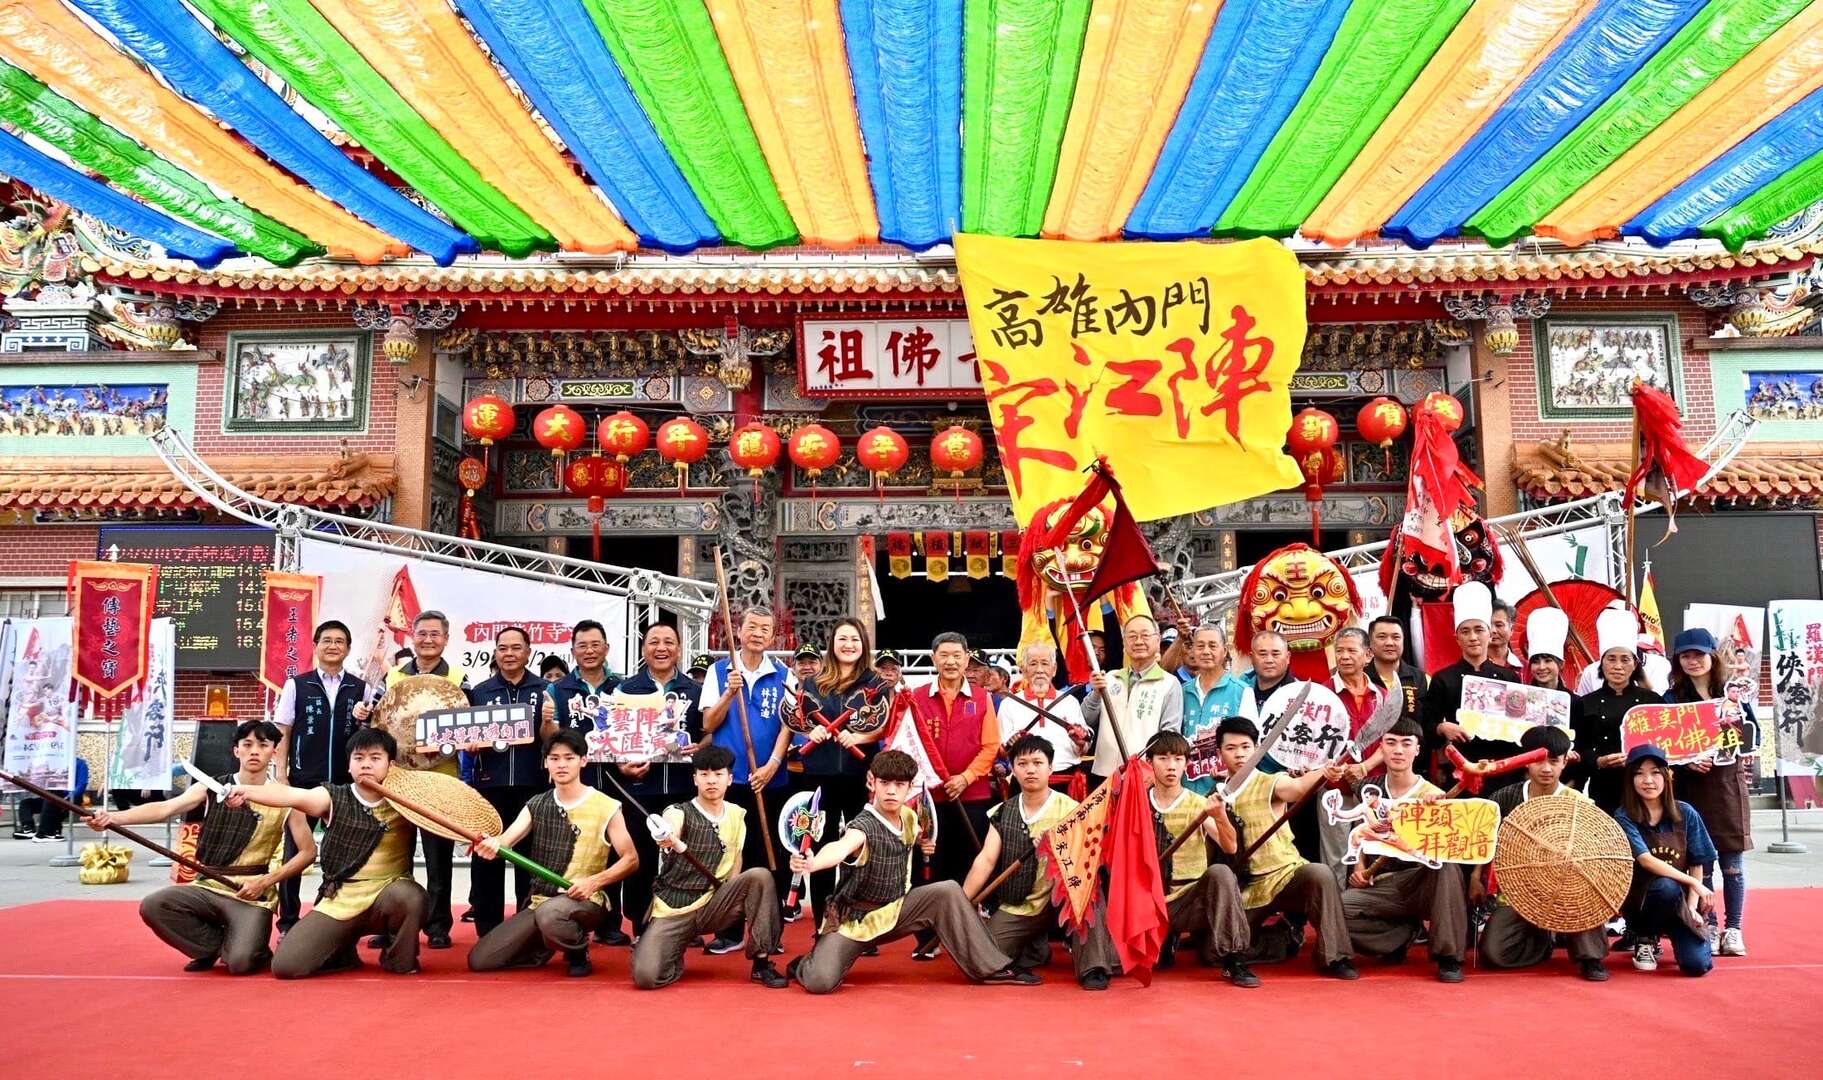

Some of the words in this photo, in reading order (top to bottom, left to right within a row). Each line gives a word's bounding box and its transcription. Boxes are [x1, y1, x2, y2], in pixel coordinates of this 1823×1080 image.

[984, 273, 1210, 349] 高雄內門
[1775, 650, 1812, 748] 俠客行
[1391, 800, 1454, 832] 陣頭
[1416, 830, 1494, 861] 拜觀音
